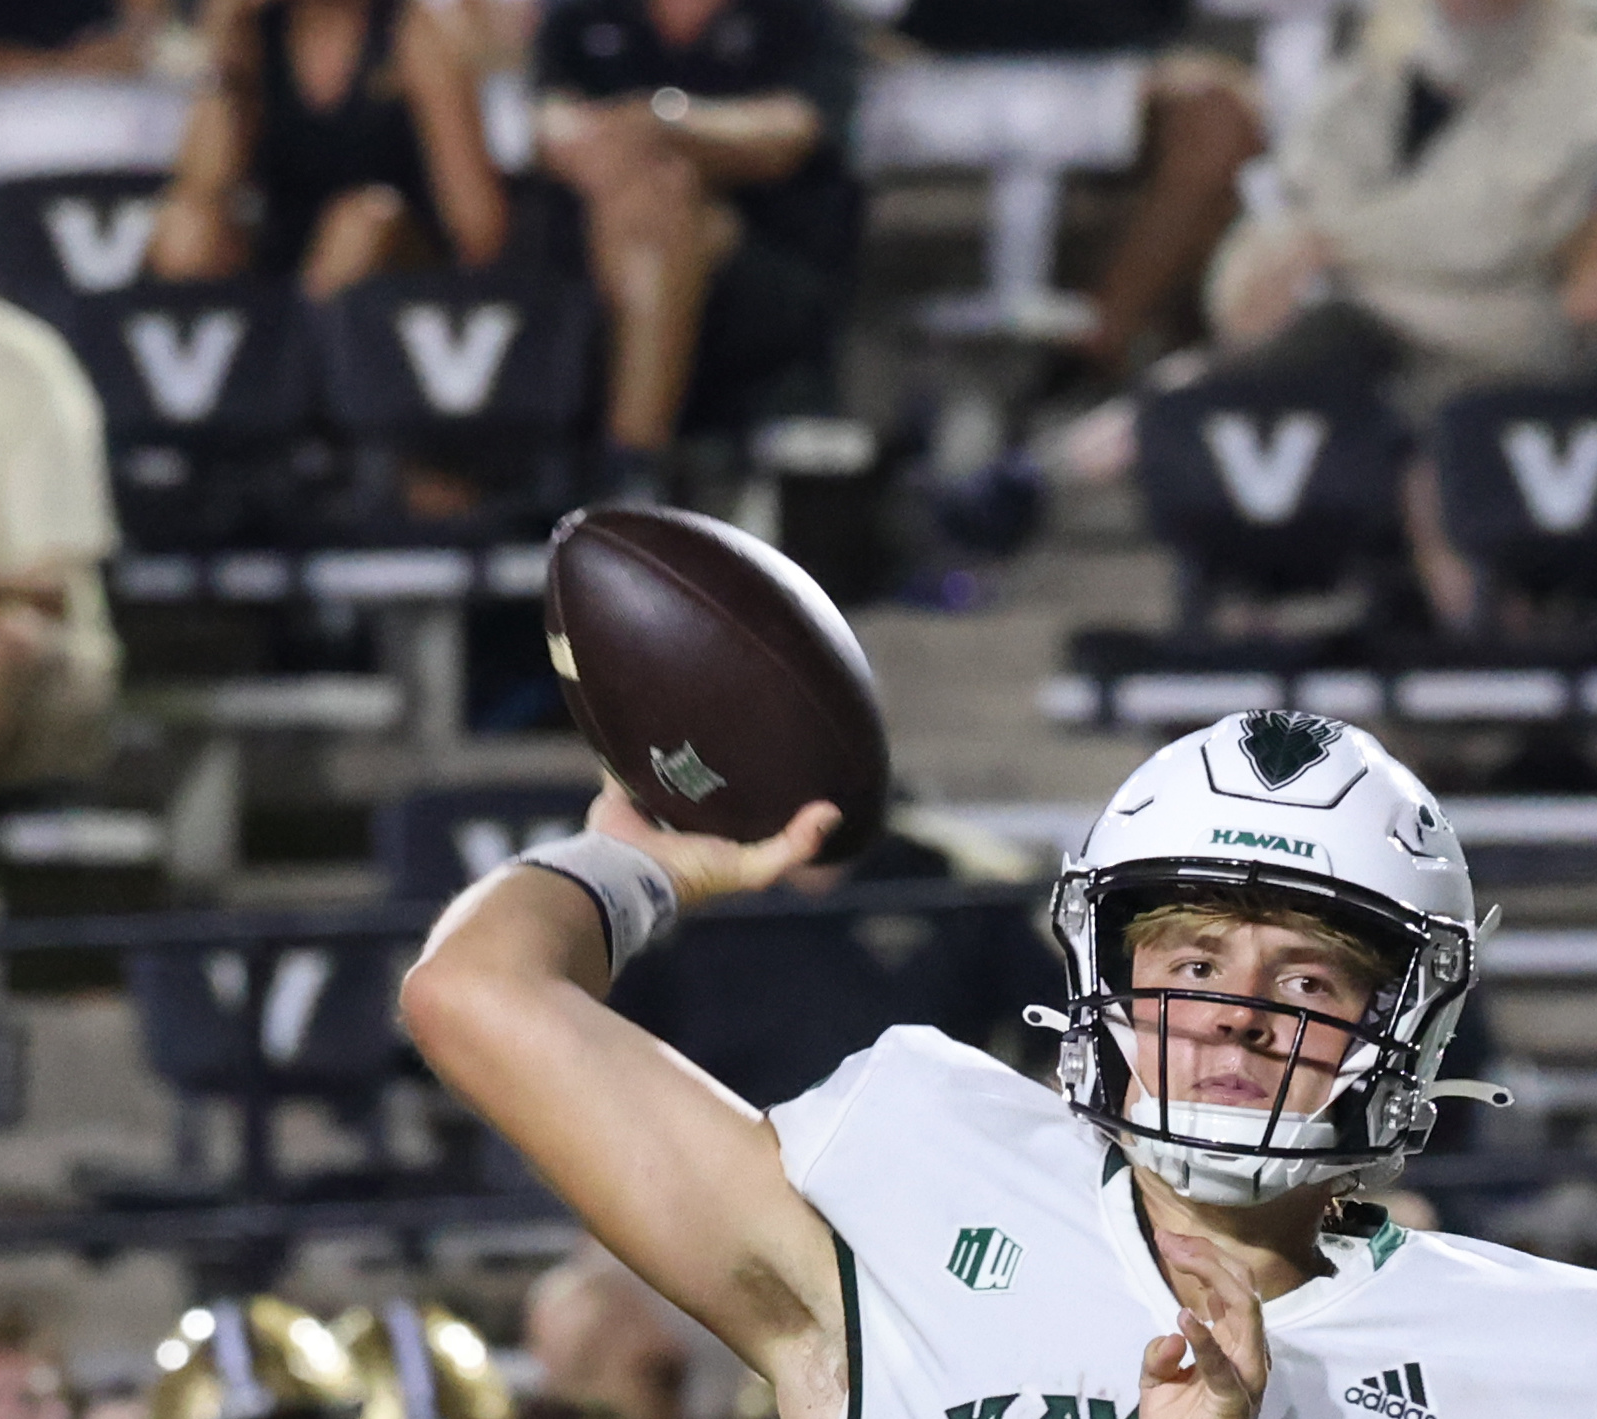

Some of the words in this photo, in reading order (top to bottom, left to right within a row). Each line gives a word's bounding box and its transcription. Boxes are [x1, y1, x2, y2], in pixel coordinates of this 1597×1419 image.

[44, 197, 156, 294] V
[122, 312, 247, 420] V
[394, 303, 519, 413] V
[1206, 412, 1329, 522] V
[1209, 829, 1317, 859] HAWAII
